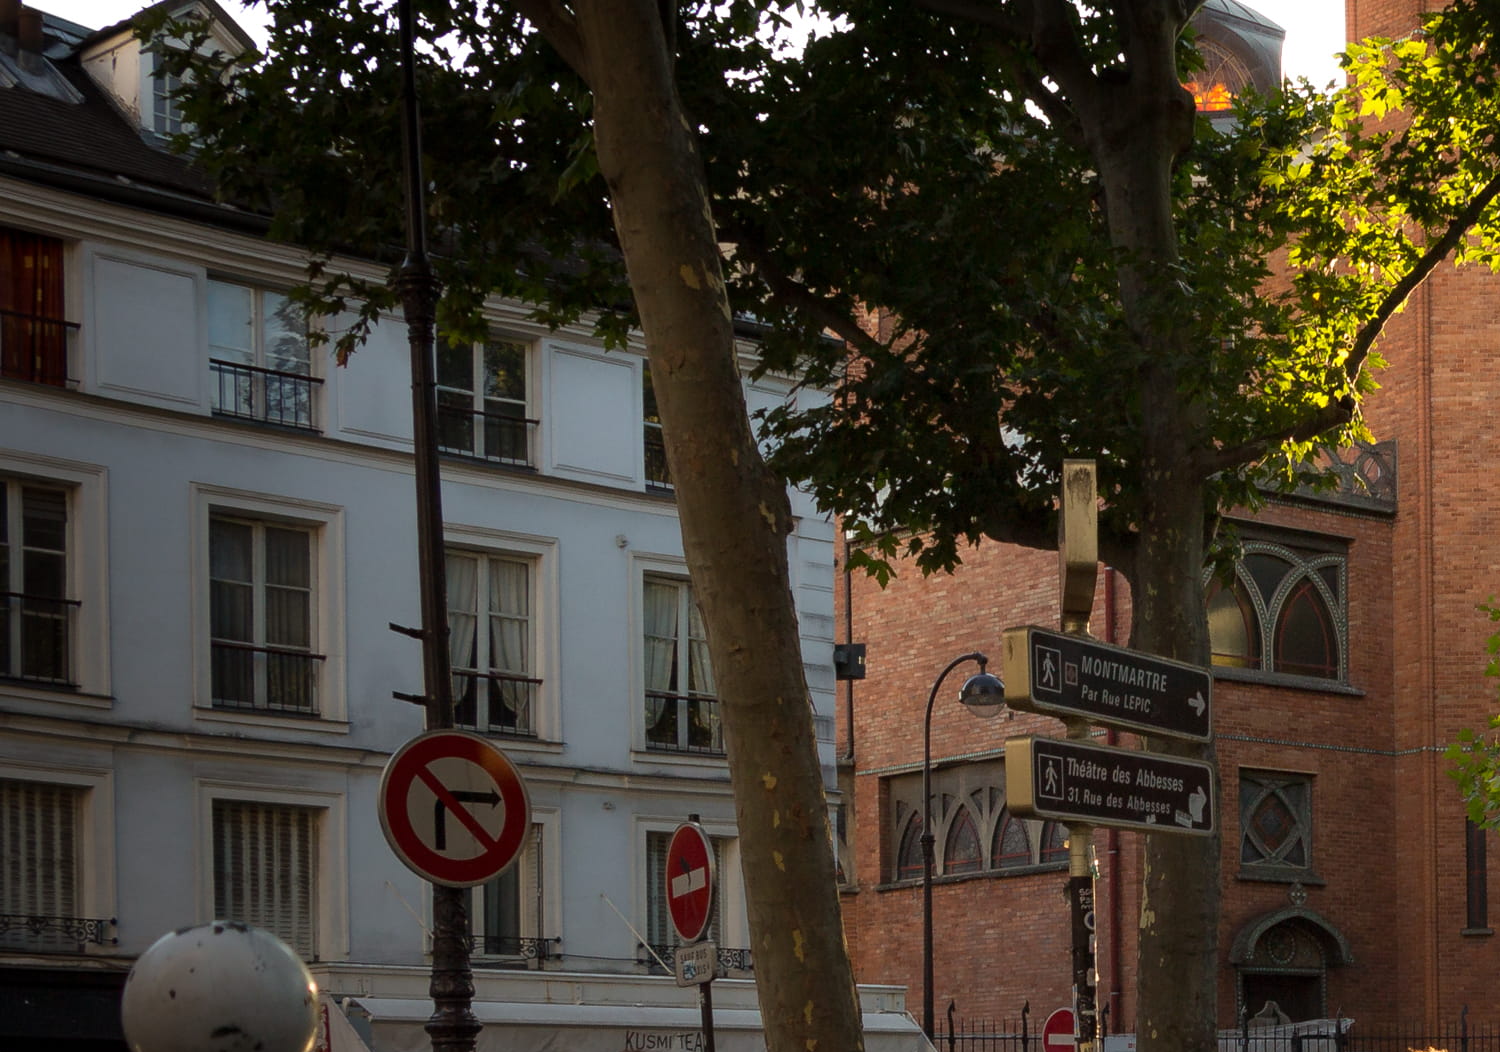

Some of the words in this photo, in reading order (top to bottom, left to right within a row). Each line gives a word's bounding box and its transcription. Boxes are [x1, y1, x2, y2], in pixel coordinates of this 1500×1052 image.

[1081, 655, 1168, 693] MONTMARTRE
[1081, 686, 1097, 702] Par
[1101, 689, 1121, 707] Rue
[1124, 693, 1152, 714] LEPIC
[1067, 757, 1108, 781] Théâtre
[1112, 764, 1131, 785] des
[1136, 768, 1184, 793] Abbesses
[1083, 789, 1103, 807] Rue
[1106, 793, 1123, 809] des
[1127, 795, 1171, 815] Abbesses
[625, 1030, 673, 1052] KUSMI
